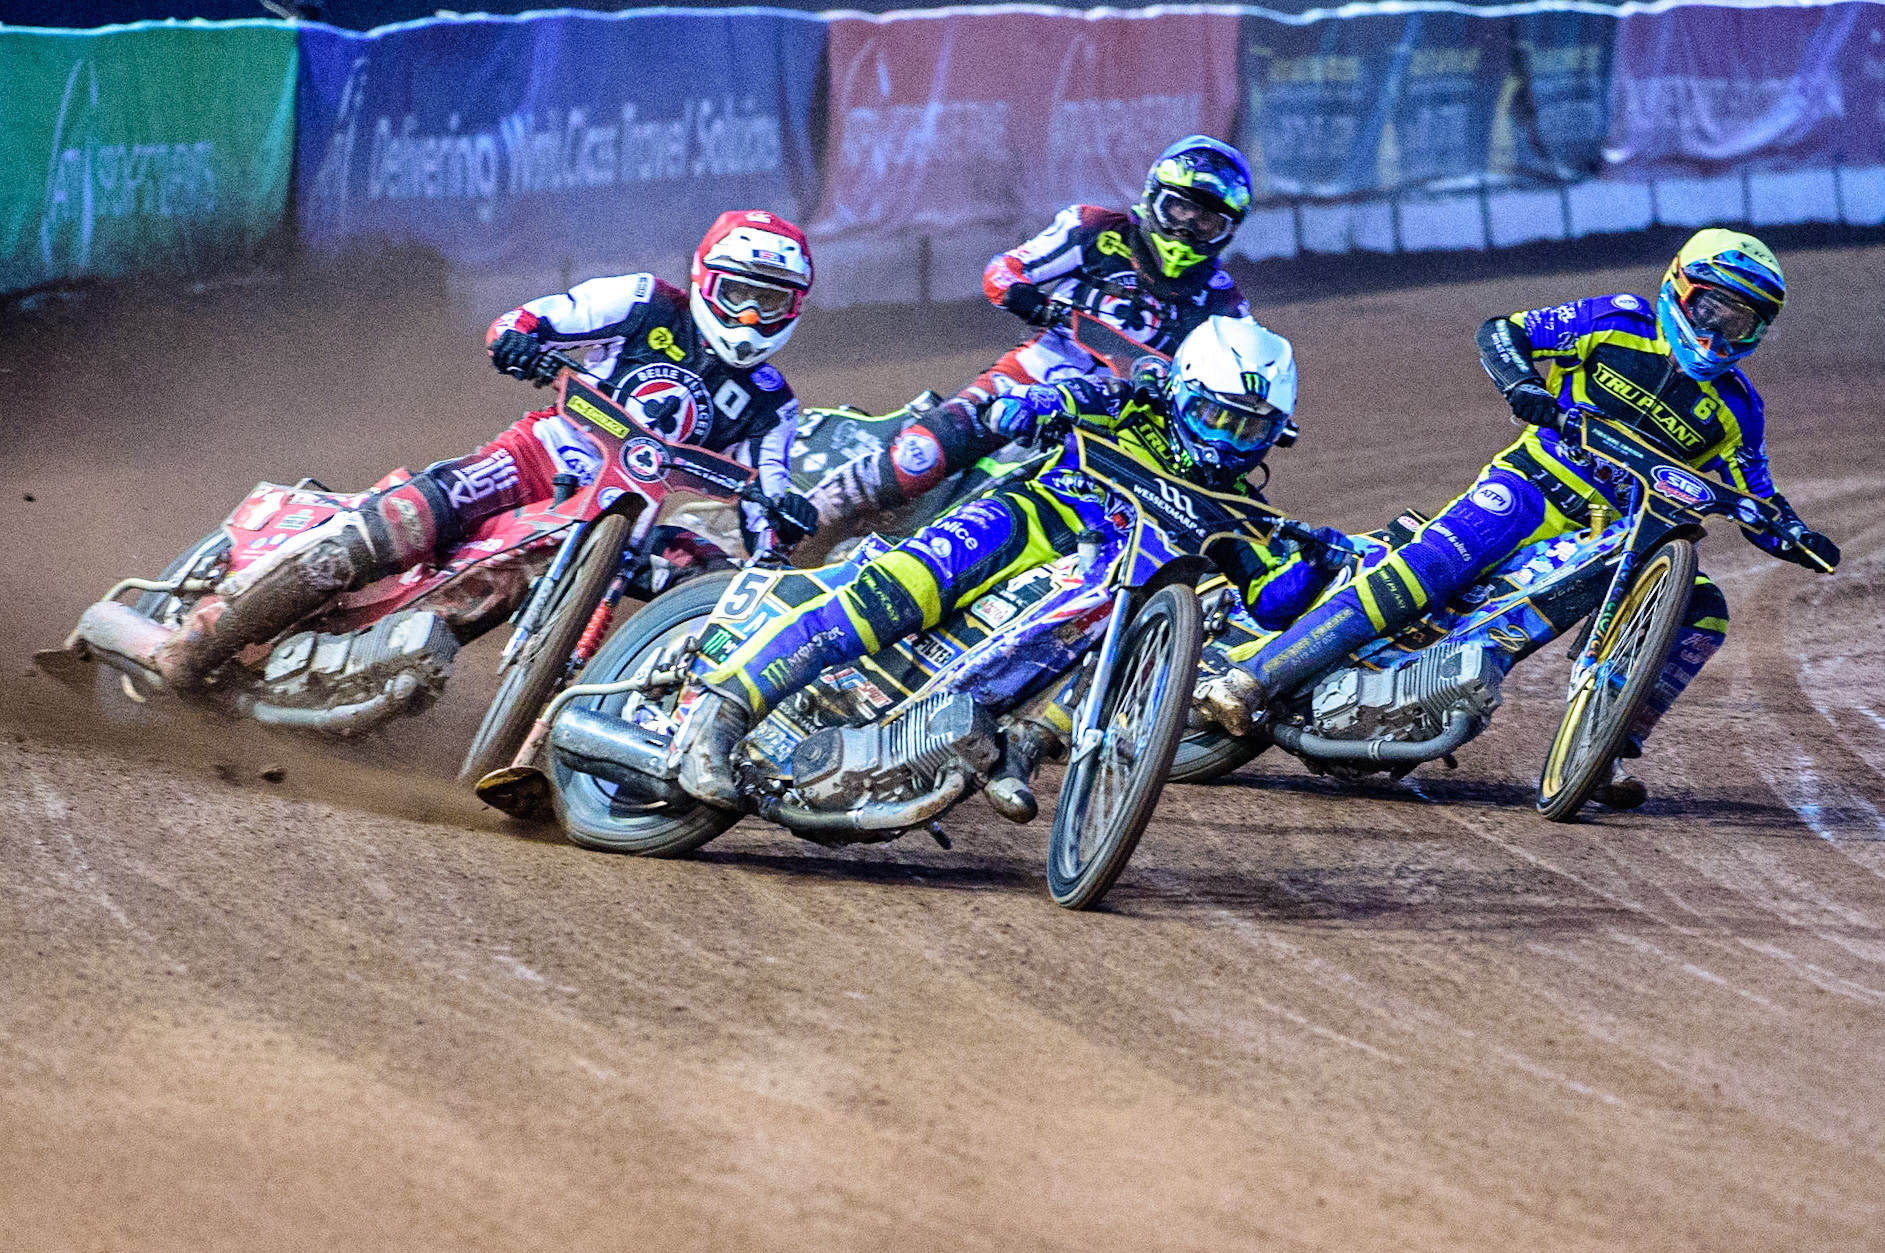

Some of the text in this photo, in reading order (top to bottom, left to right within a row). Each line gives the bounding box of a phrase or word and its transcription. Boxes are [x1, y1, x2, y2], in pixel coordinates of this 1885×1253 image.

[638, 367, 679, 383] BELLE
[1598, 371, 1640, 400] TRU
[1636, 394, 1700, 447] PLANT
[1692, 396, 1718, 422] 6
[1480, 489, 1507, 508] ATPI
[938, 519, 980, 551] Nice
[723, 572, 769, 616] 5
